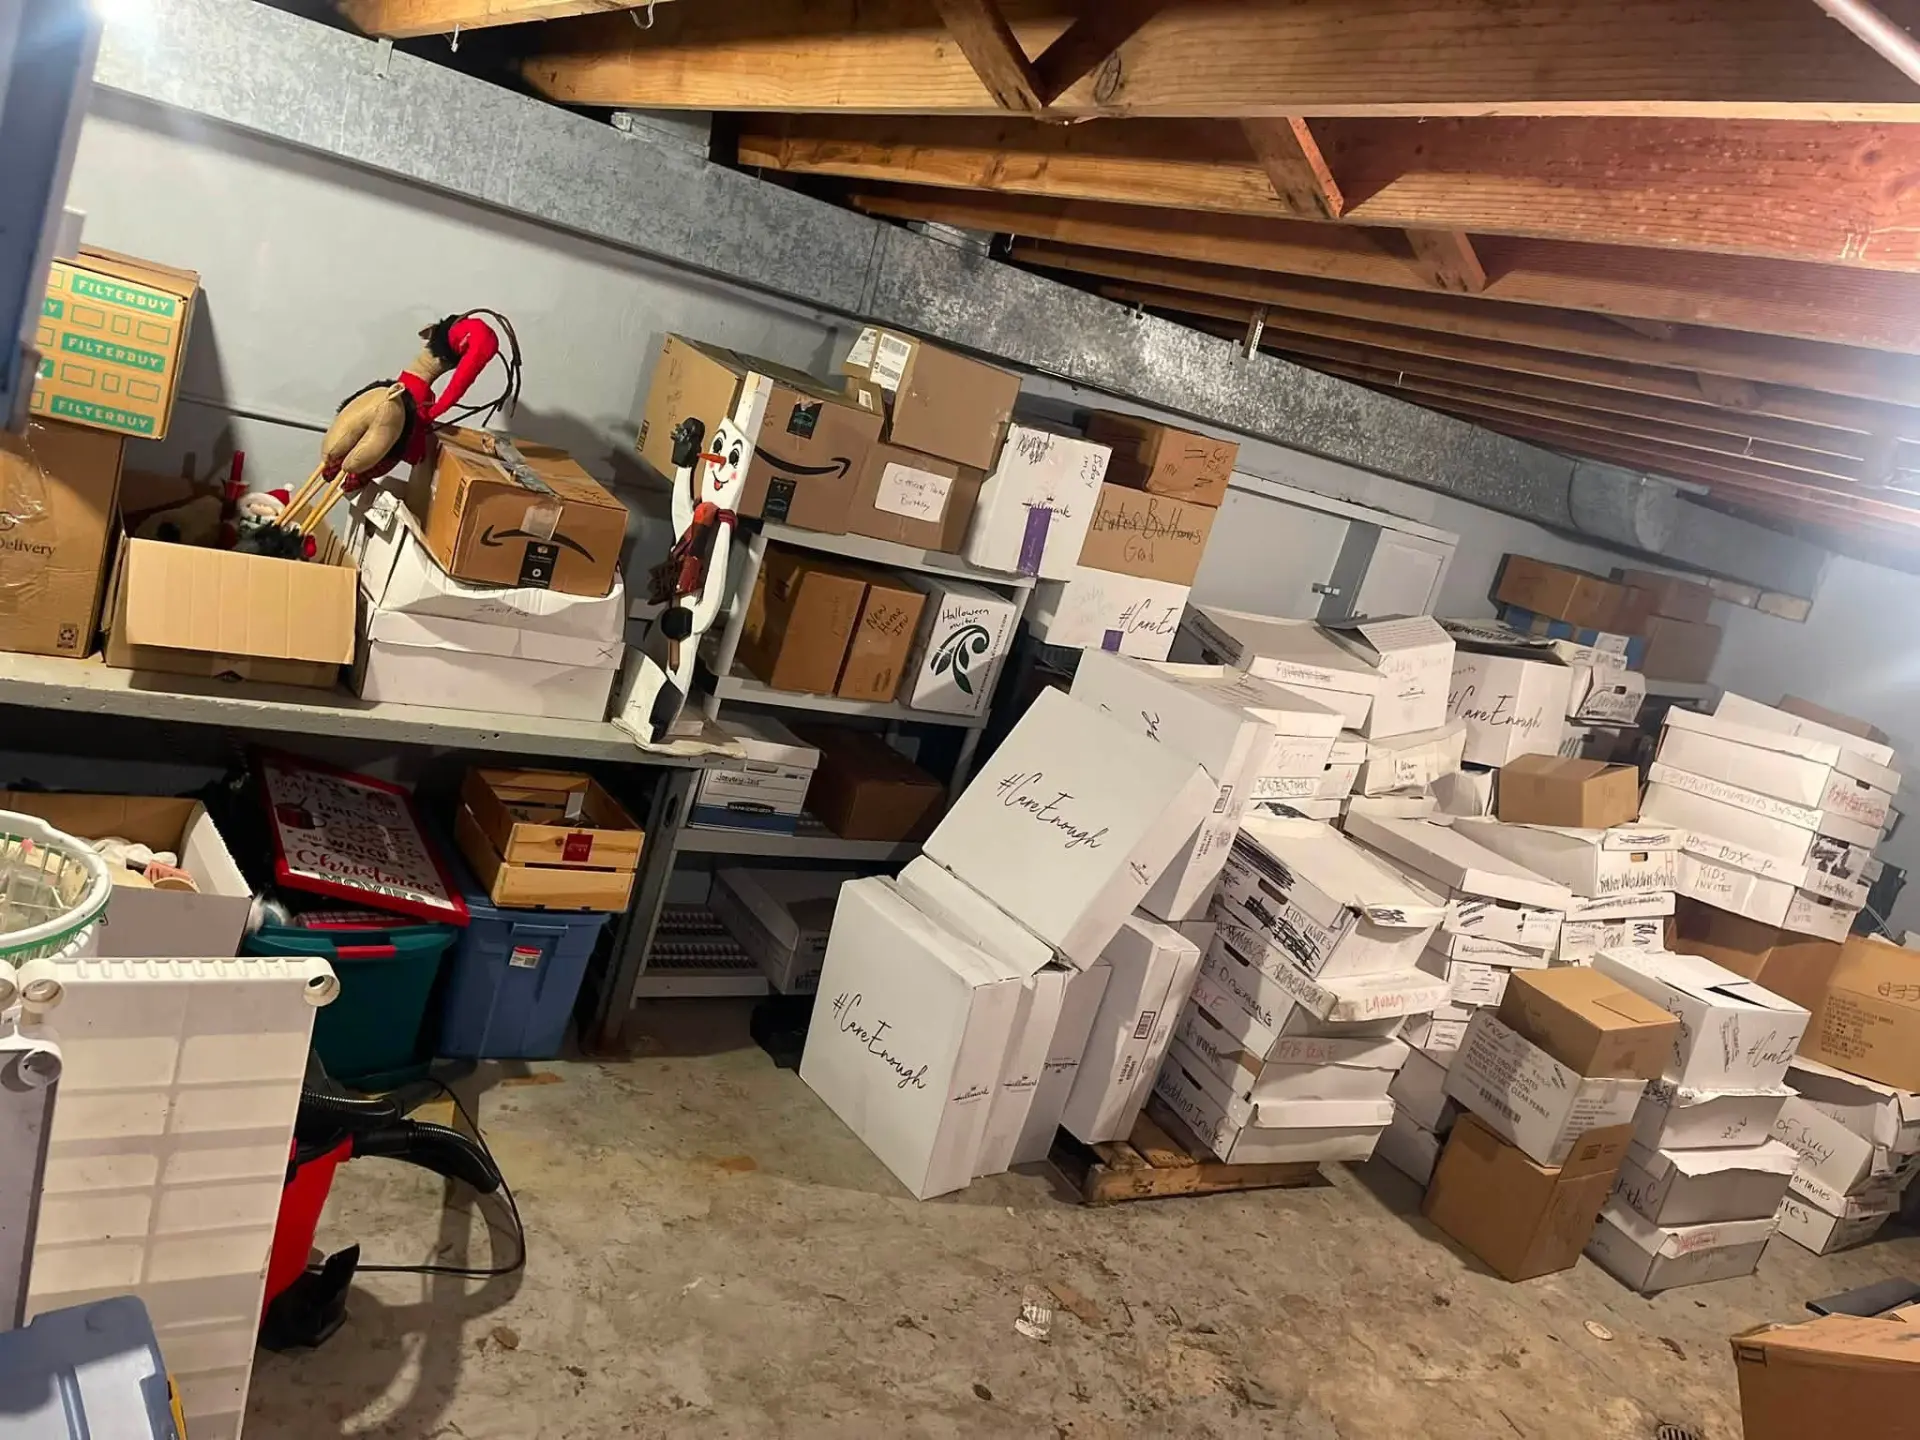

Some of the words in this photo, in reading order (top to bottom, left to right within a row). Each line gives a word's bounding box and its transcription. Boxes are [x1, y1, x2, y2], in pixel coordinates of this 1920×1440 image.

[78, 279, 170, 312] FILTERBUY
[67, 337, 160, 369] FILTERBUY
[57, 400, 150, 429] FILTERBUY
[942, 605, 990, 623] Halloween
[997, 772, 1109, 849] #CareEnough
[295, 849, 438, 895] Christmas
[1283, 905, 1304, 929] KIDS
[832, 992, 930, 1090] #CareEnough
[952, 1086, 990, 1101] Hallmark
